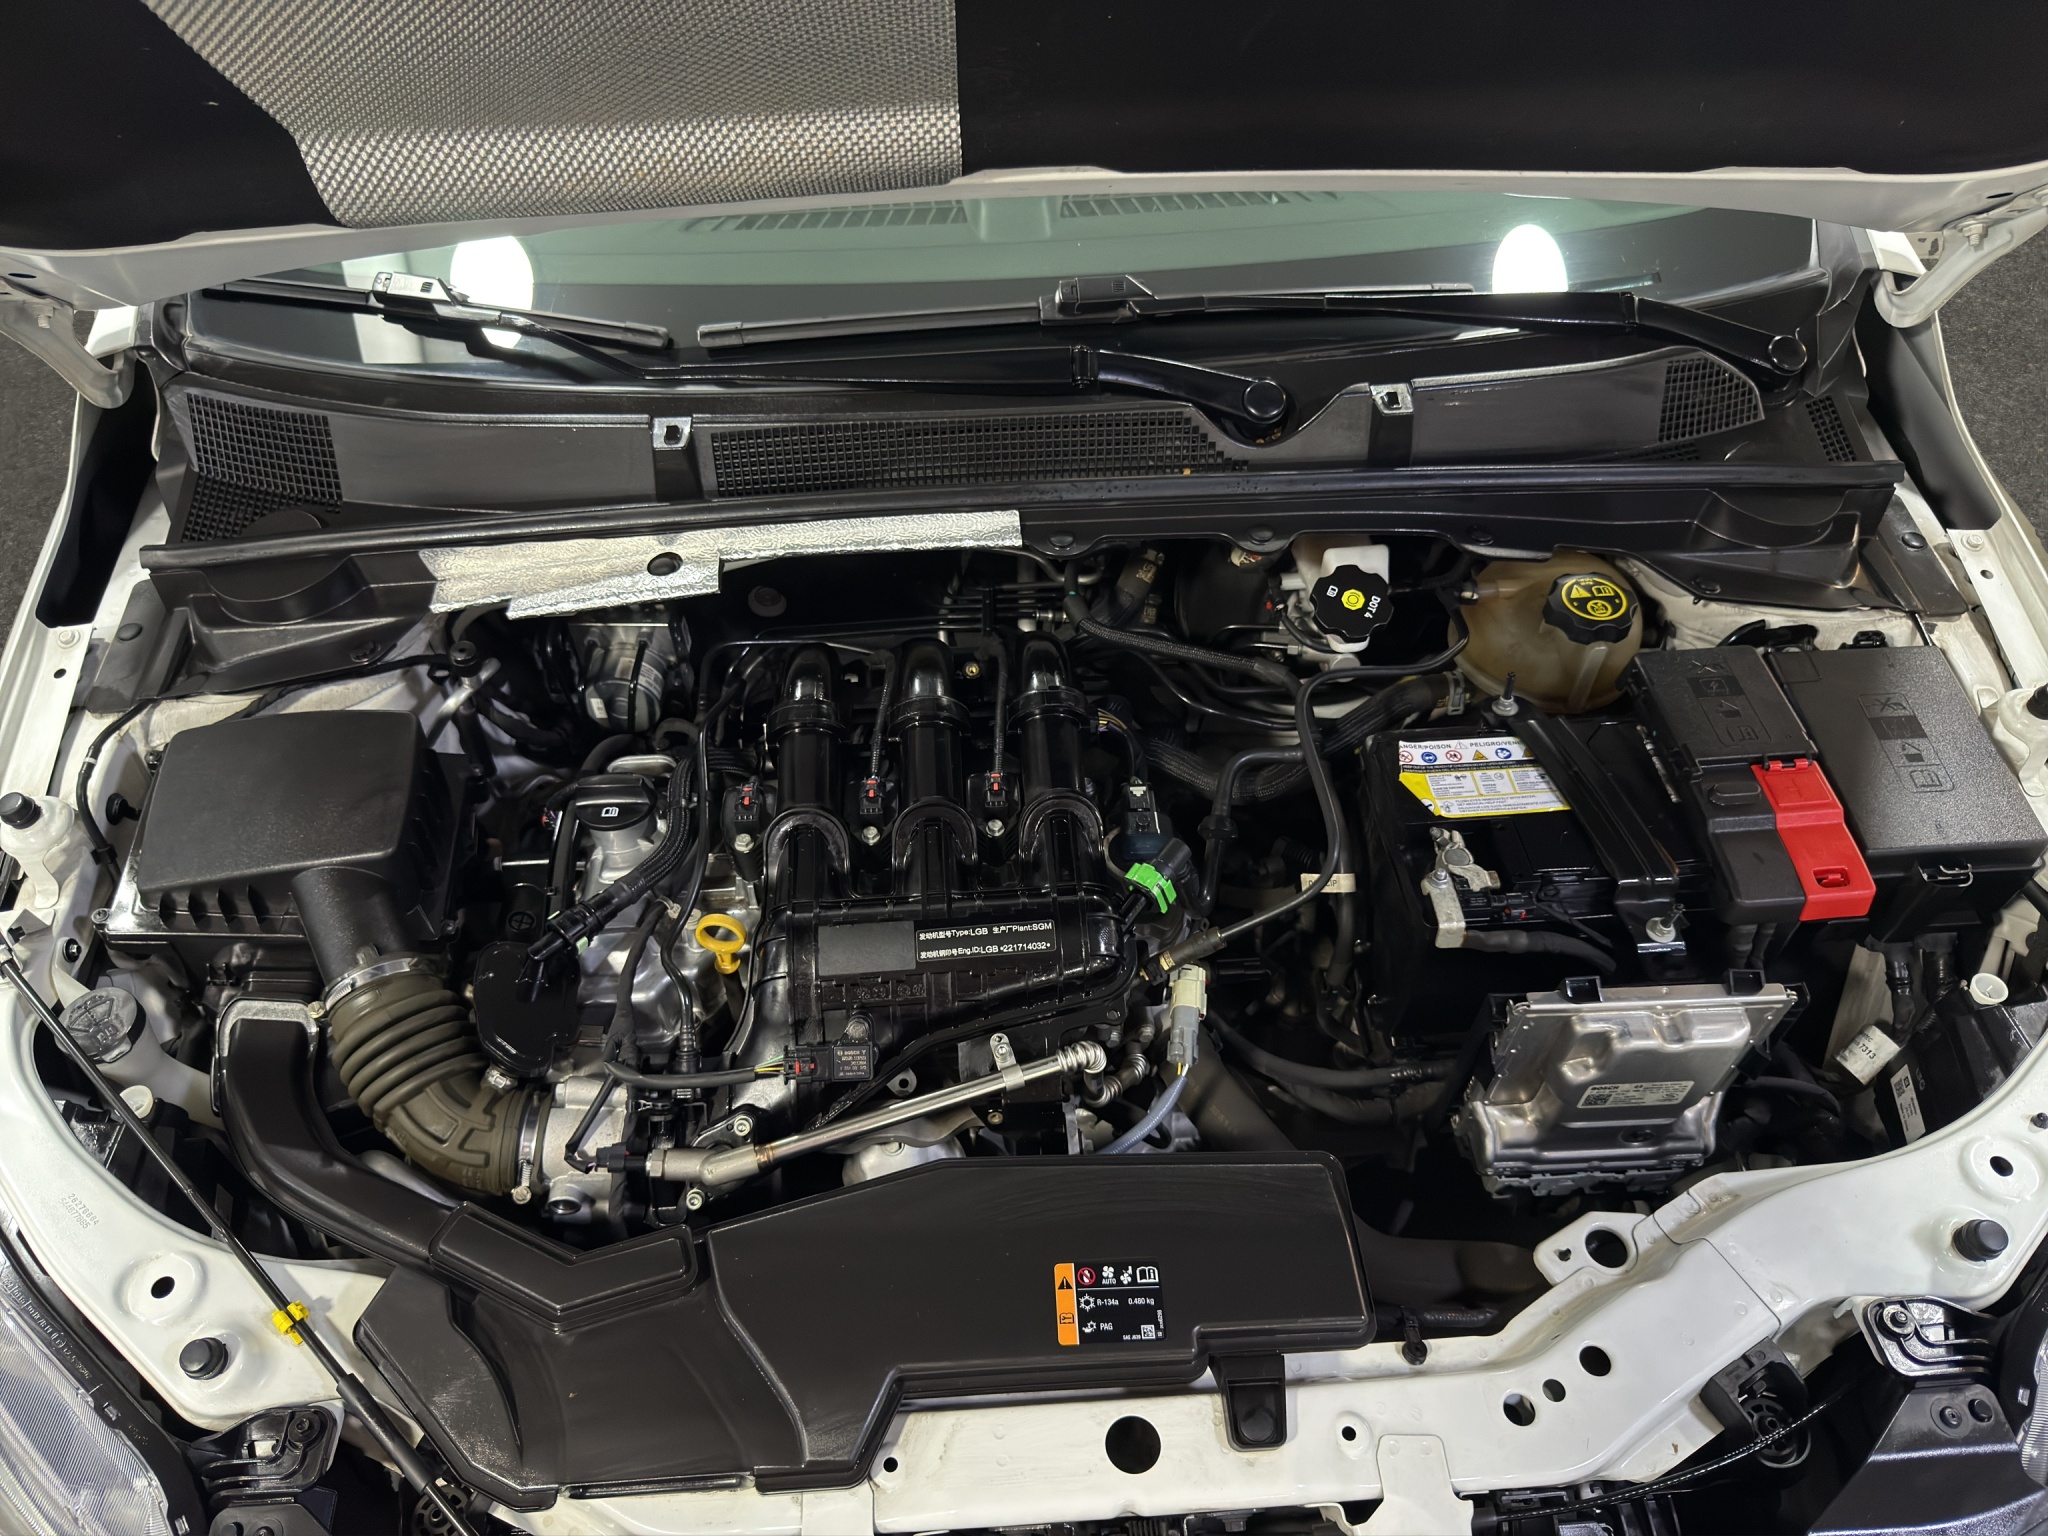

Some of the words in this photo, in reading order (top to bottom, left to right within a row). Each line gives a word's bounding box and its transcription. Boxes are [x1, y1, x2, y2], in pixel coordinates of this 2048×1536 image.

[1369, 595, 1381, 614] DOT
[1146, 1296, 1155, 1306] kg
[1100, 1322, 1113, 1330] PAG
